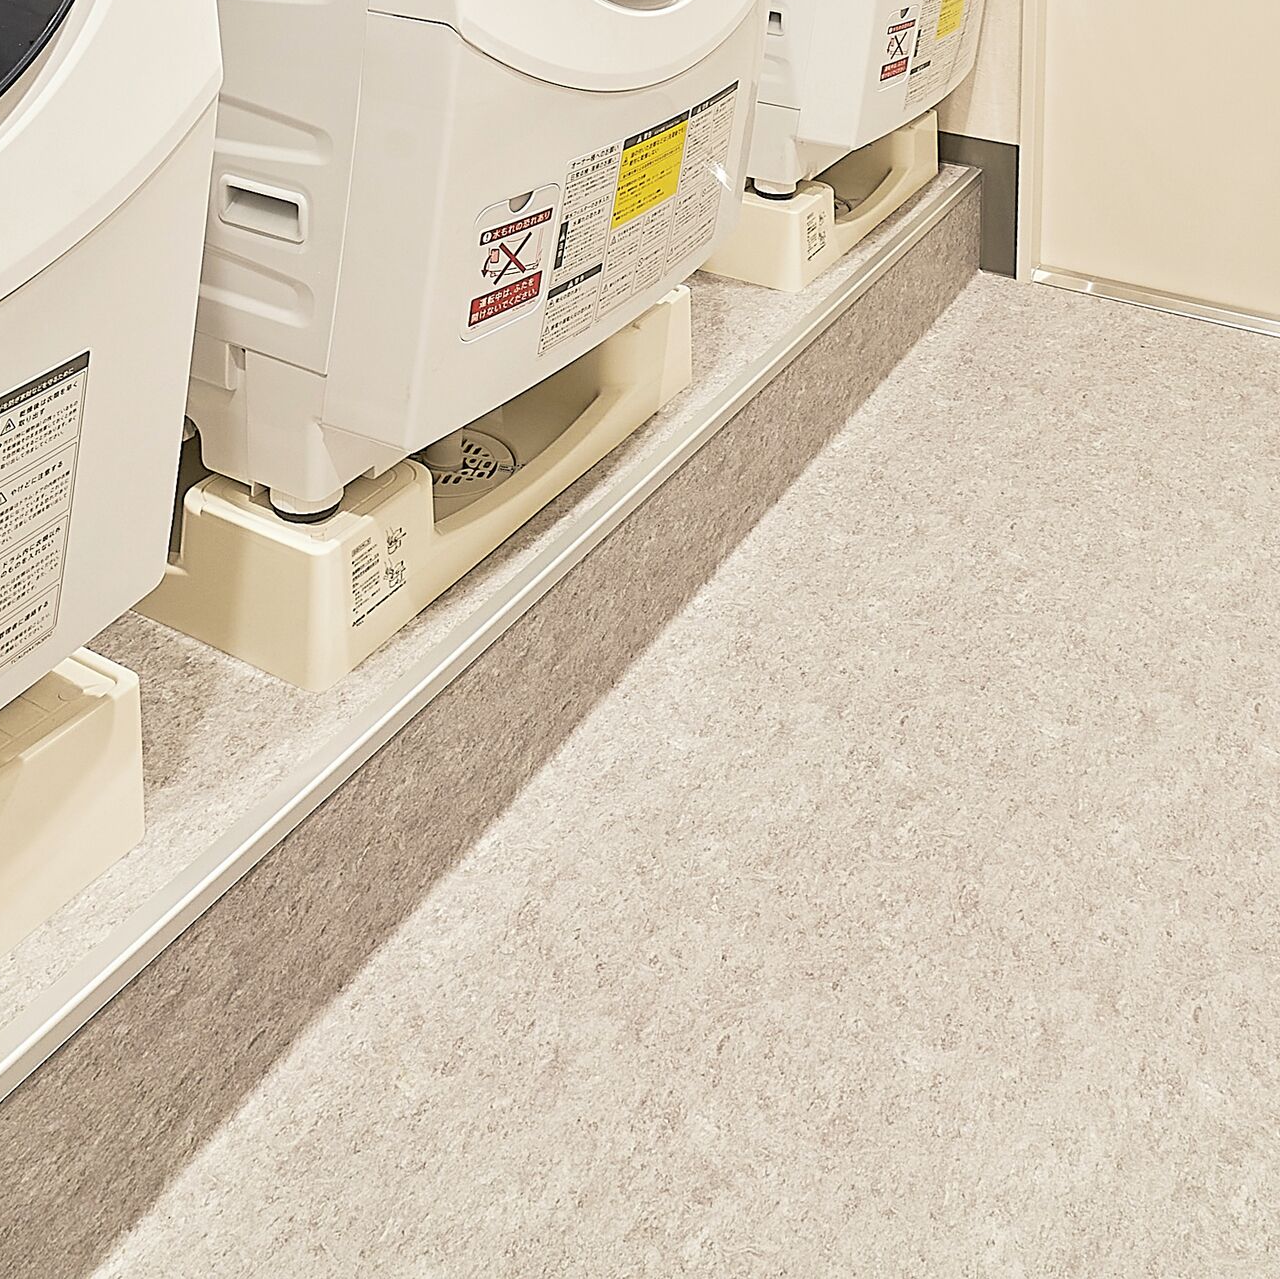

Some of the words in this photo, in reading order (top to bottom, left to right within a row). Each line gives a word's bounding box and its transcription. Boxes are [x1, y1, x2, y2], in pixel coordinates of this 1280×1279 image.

[492, 210, 550, 239] 水もれの恐れあり
[479, 278, 535, 308] 運転中は、ふたを
[10, 460, 64, 497] やけどに注意する
